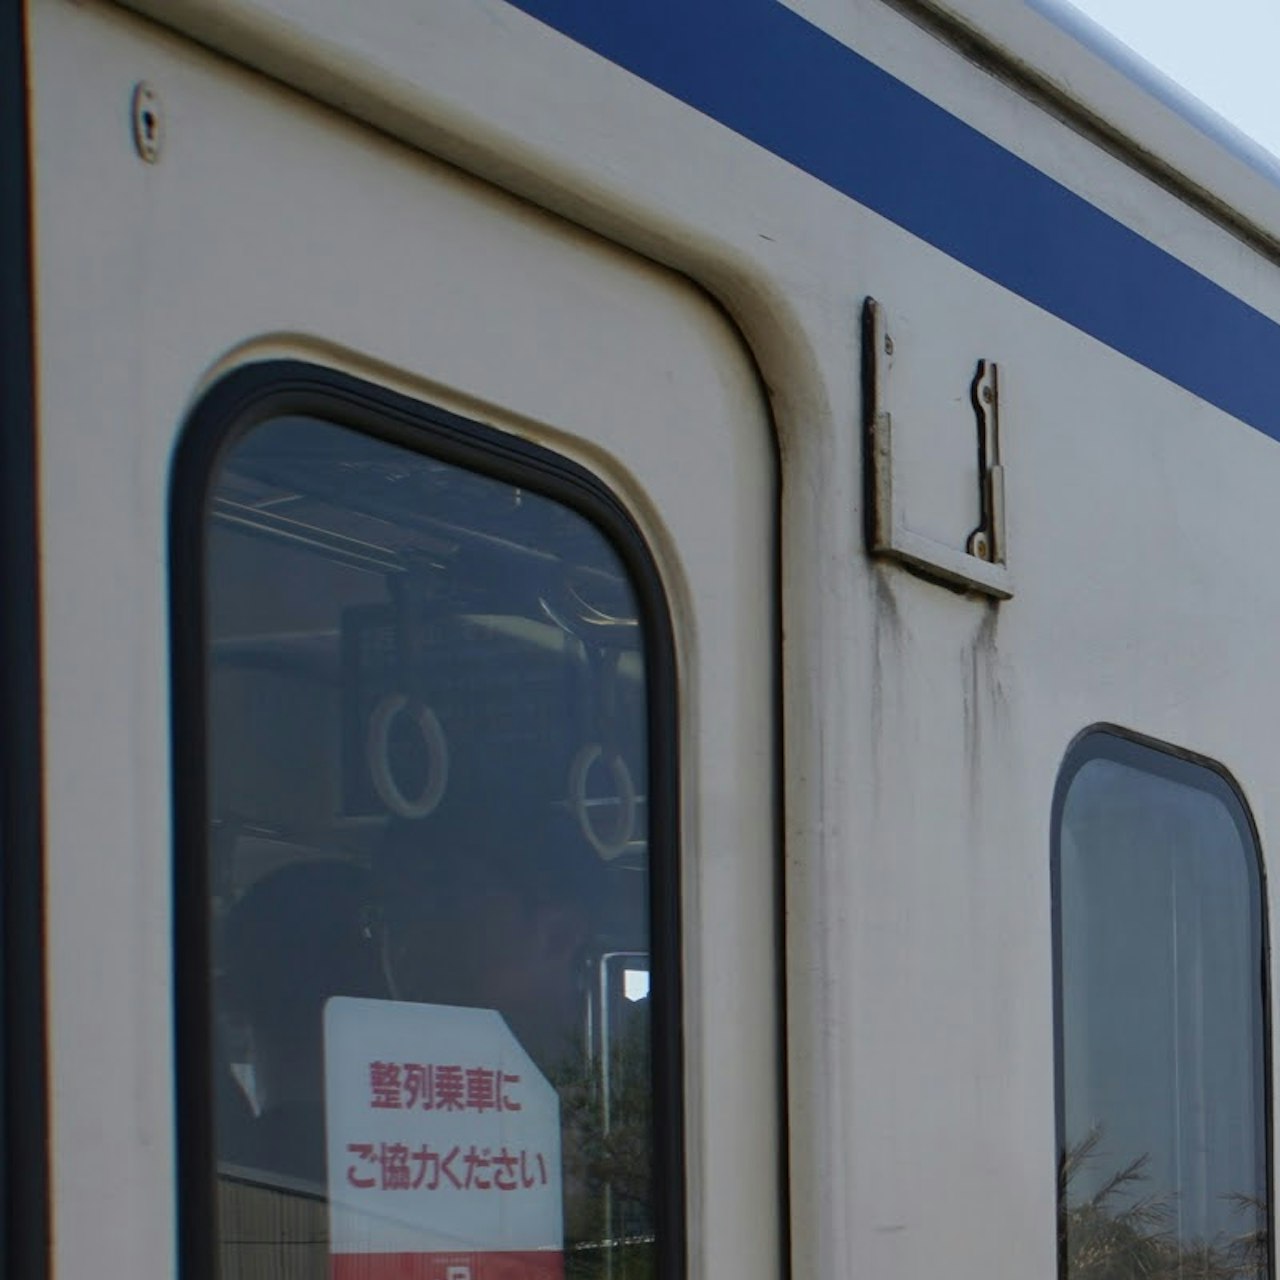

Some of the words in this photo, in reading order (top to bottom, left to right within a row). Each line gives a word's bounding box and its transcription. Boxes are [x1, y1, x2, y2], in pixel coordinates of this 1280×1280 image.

[369, 1061, 522, 1113] 整列乗車に
[347, 1142, 548, 1191] ご協力ください
